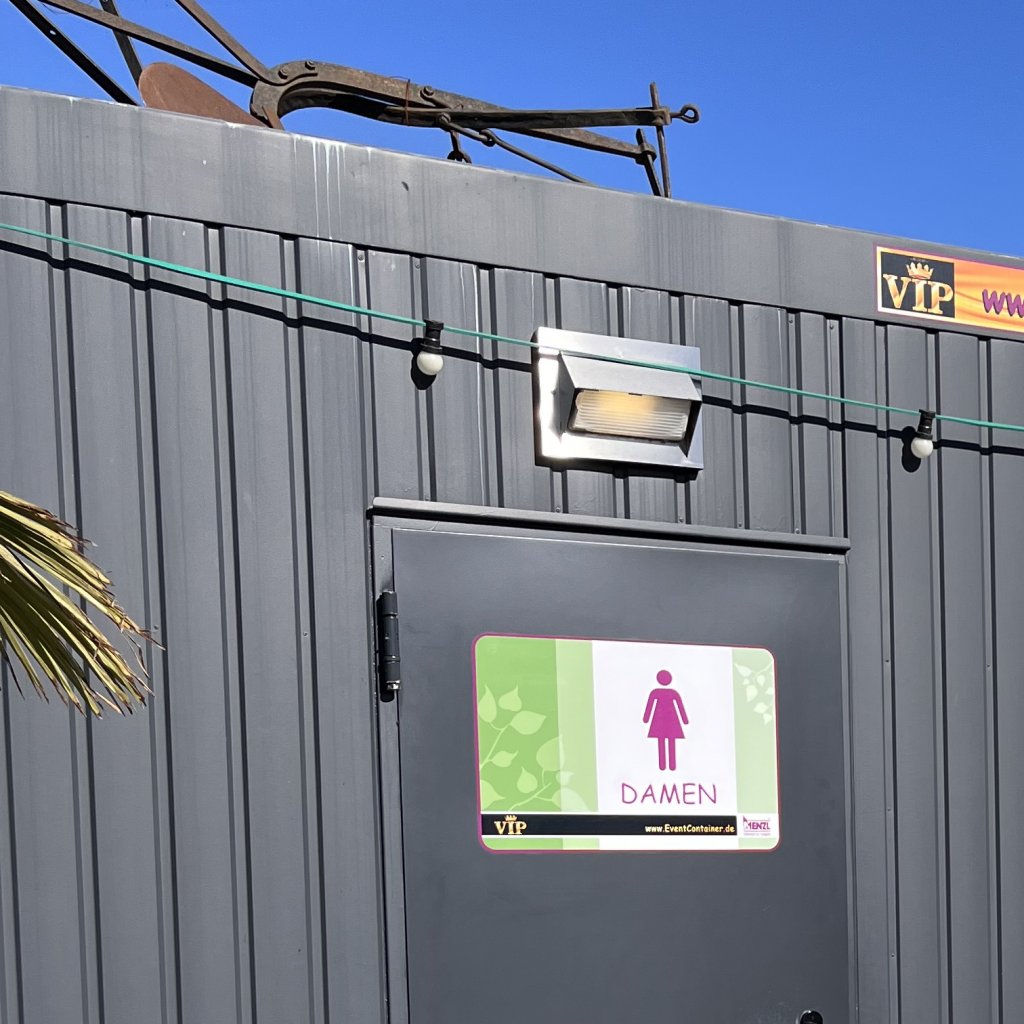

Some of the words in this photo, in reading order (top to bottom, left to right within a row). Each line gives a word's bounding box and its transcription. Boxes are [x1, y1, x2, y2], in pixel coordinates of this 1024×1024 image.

[882, 273, 954, 314] VIP
[621, 782, 717, 805] DAMEN
[494, 820, 527, 835] VIP
[644, 823, 736, 833] www.EventContainer.de
